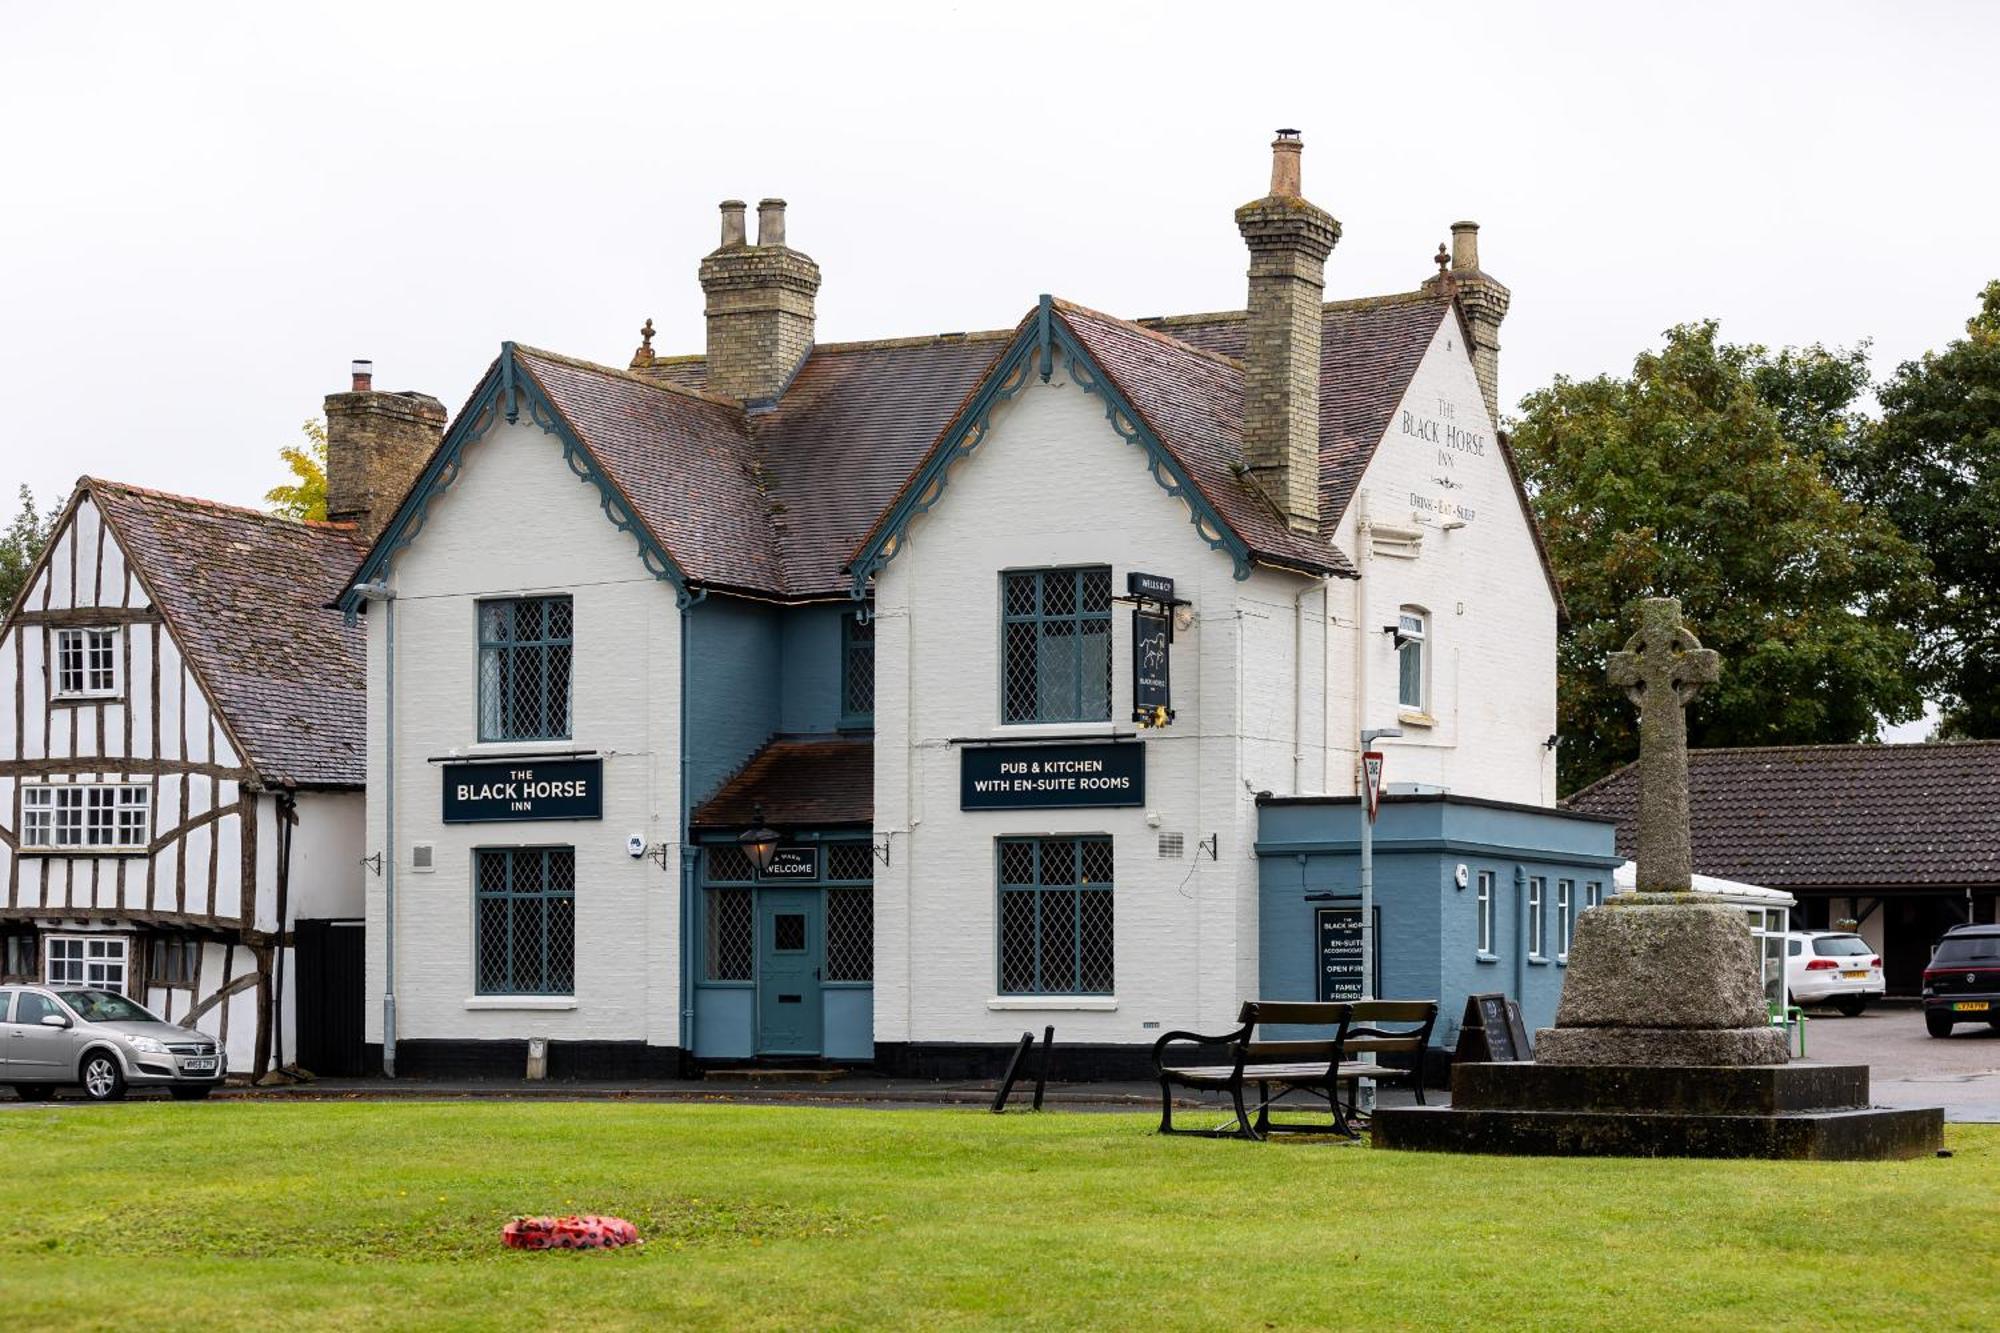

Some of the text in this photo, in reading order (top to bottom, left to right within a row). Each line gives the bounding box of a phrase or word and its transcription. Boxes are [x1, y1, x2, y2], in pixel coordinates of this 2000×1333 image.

[1438, 398, 1455, 420] THE
[1403, 410, 1484, 456] BLACK HORSE
[1438, 448, 1455, 468] INN
[1001, 760, 1102, 774] PUB & KITCHEN
[510, 770, 533, 780] THE
[457, 781, 586, 800] BLACK HORSE
[975, 777, 1129, 792] WITH EN-SUITE ROOMS
[511, 801, 531, 811] INN
[767, 864, 812, 873] WELCOME
[1326, 965, 1347, 973] OPEN
[1330, 992, 1362, 1000] FRIENDL
